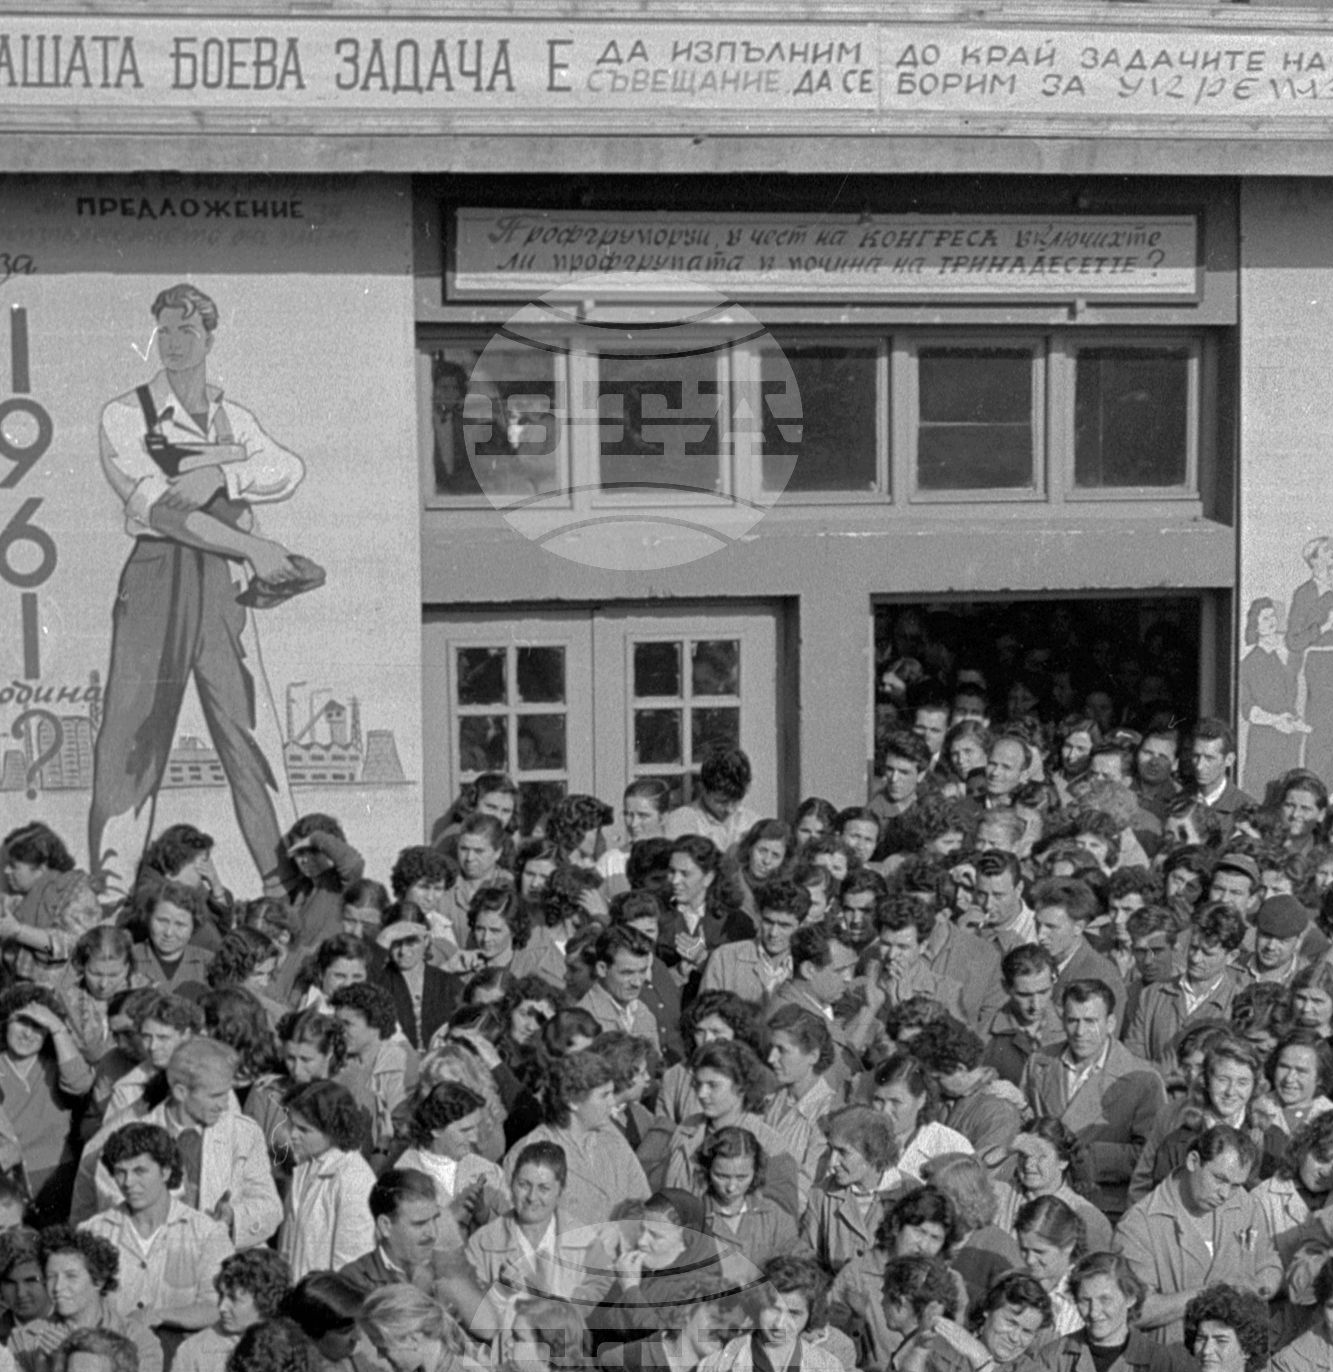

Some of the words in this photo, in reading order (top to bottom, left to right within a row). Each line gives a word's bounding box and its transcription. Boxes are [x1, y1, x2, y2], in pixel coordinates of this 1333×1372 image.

[170, 37, 305, 92] БОЕВА
[335, 38, 516, 95] ЗАДАЧА
[547, 39, 574, 92] Е
[596, 39, 649, 66] ДА
[671, 40, 863, 65] ИЗПЪЛНИМ
[896, 44, 940, 69] ДО
[961, 40, 1056, 68] КРАЙ
[1081, 47, 1265, 73] ЗАДАЧИТЕ
[1283, 51, 1326, 73] НА
[792, 69, 833, 96] ДА
[842, 69, 874, 94] СЕ
[898, 72, 1017, 97] БОРИМ
[1041, 73, 1086, 97] ЗА
[75, 196, 306, 221] ПРЕДЛОЖЕНИЕ
[815, 229, 849, 247] на
[858, 228, 999, 248] КОНГРЕСА
[893, 255, 926, 275] на
